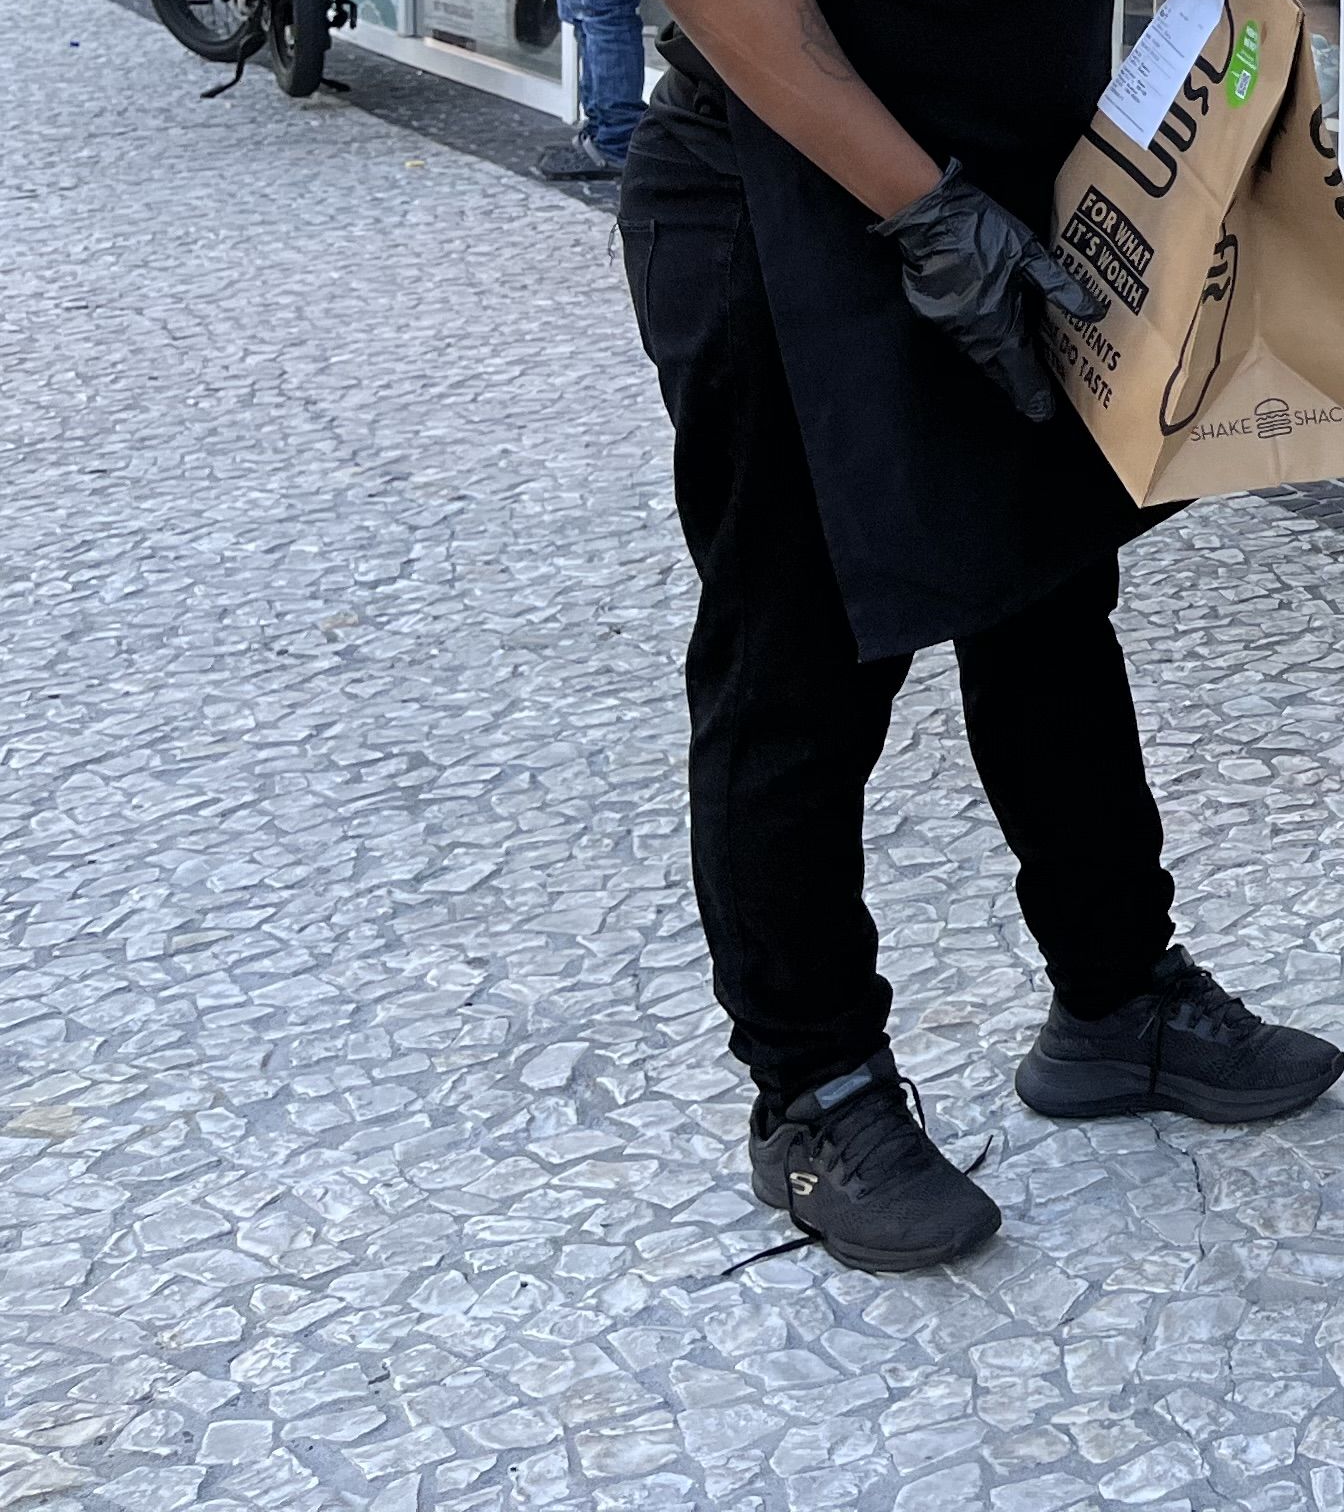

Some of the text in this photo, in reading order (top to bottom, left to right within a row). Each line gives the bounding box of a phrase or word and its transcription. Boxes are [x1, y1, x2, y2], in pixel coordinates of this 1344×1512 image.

[1066, 219, 1101, 257] IT'S
[1081, 192, 1118, 234] FOR
[1114, 220, 1151, 271] WHAT
[1078, 356, 1113, 410] TASTE
[1190, 417, 1253, 443] SHAKE
